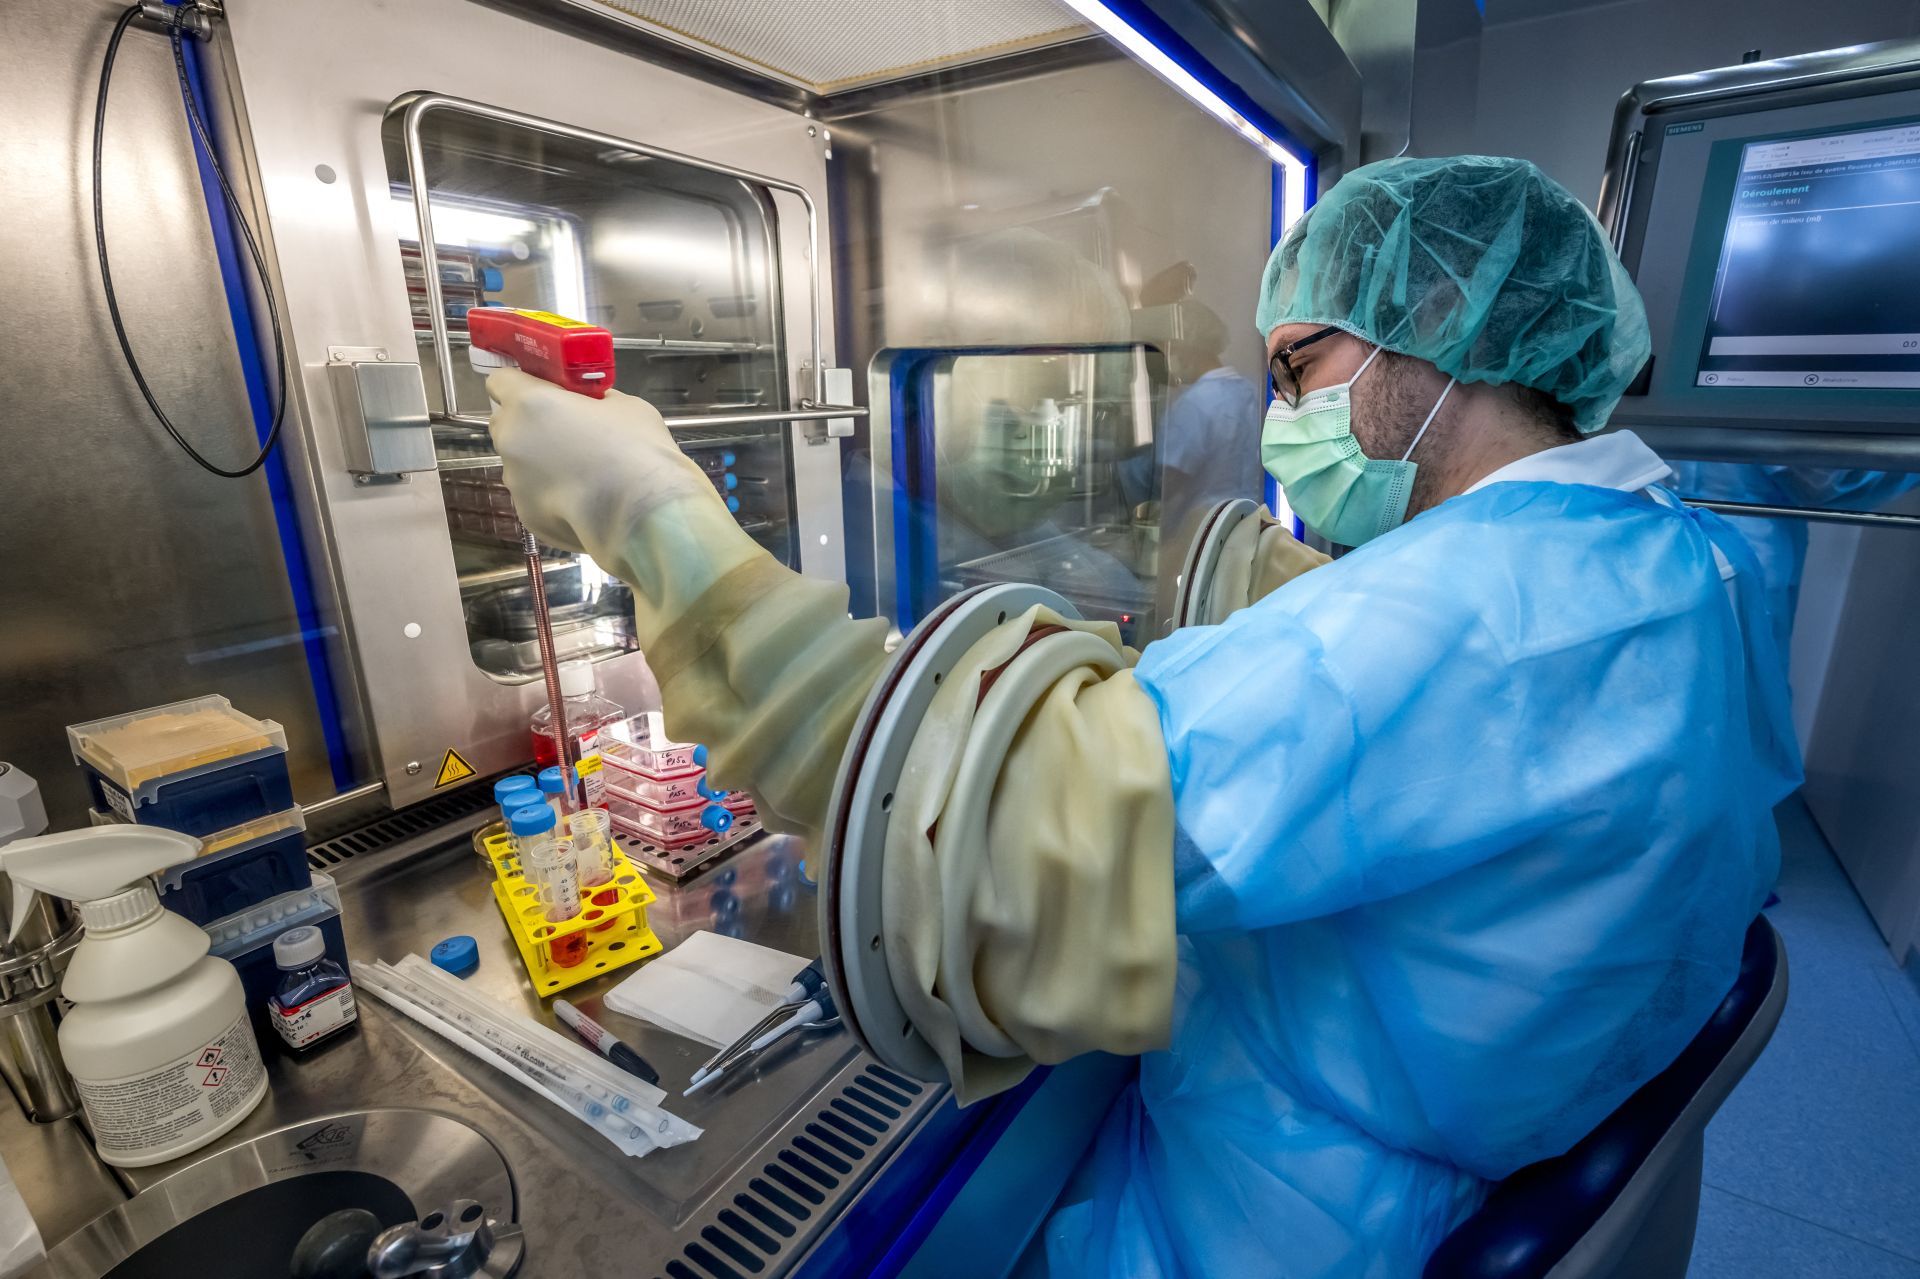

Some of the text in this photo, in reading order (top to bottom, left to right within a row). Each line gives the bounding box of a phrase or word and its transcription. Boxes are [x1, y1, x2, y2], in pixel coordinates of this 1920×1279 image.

[1668, 124, 1703, 134] SIEMENS
[1742, 184, 1810, 199] Déroulement
[515, 332, 538, 348] INTEGRA
